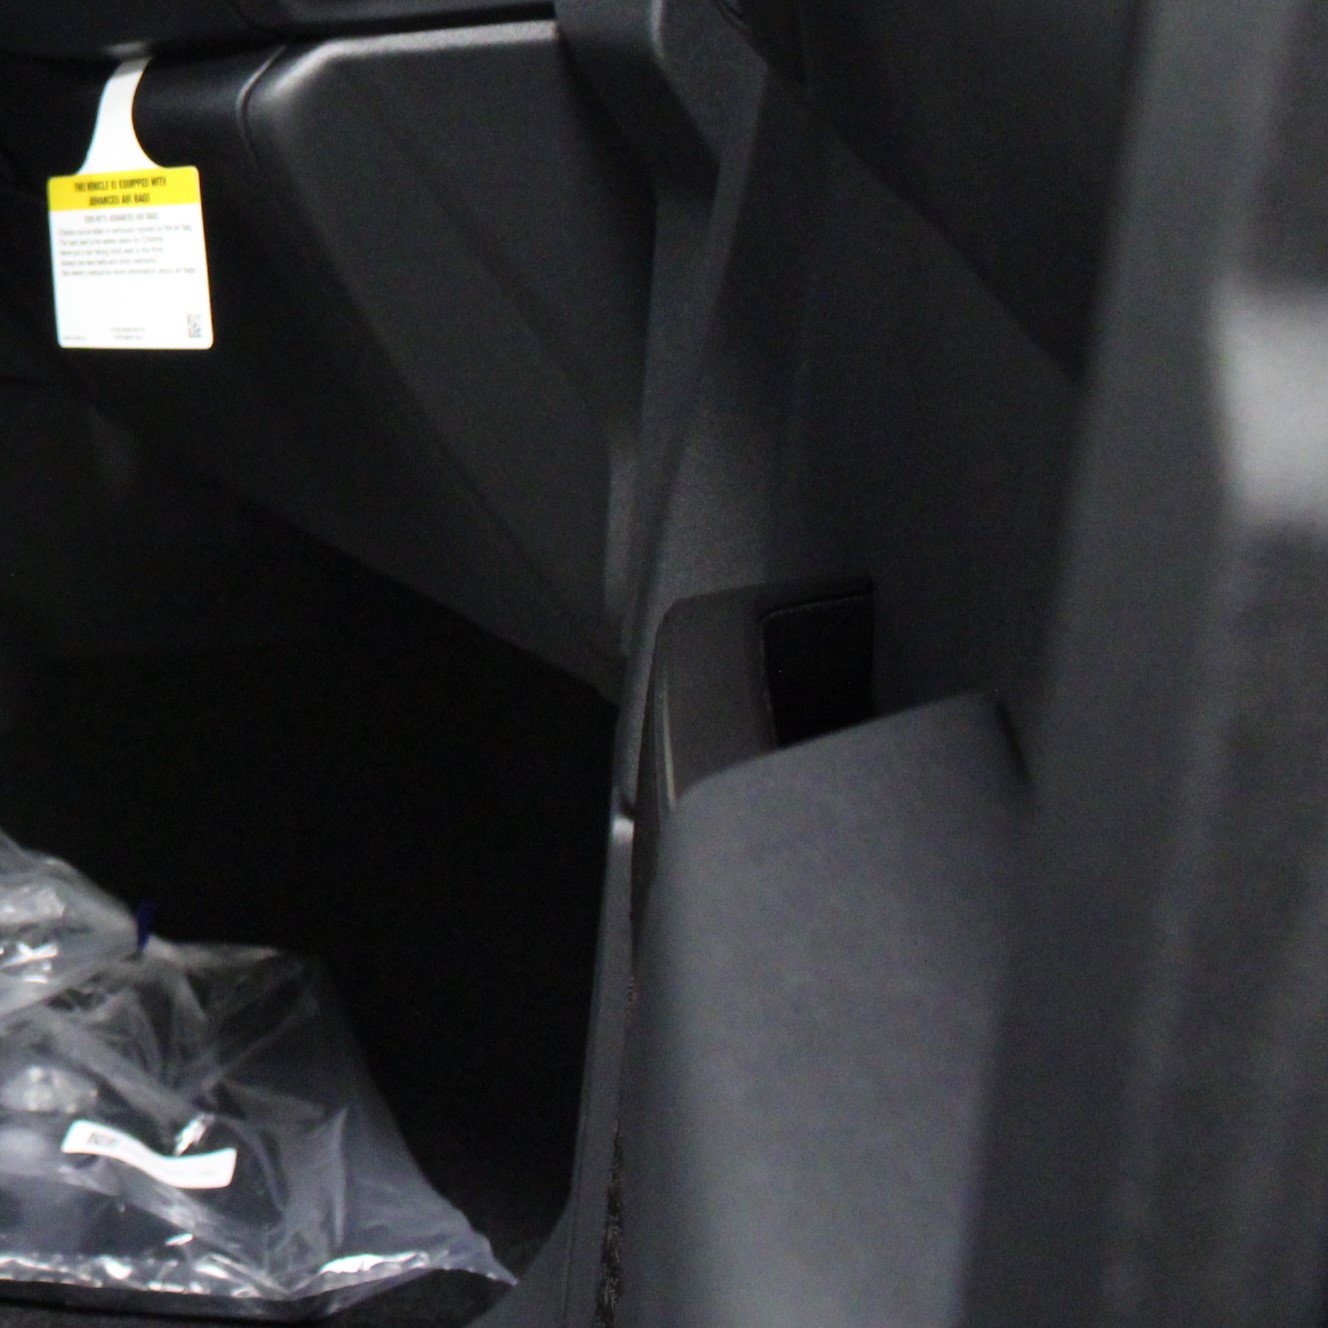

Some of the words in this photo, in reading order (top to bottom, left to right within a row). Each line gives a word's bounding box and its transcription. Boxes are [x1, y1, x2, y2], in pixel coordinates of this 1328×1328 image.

[119, 178, 150, 189] EQUIPPED
[151, 176, 167, 186] WITH
[122, 194, 132, 204] AIR
[134, 193, 150, 203] BAGS
